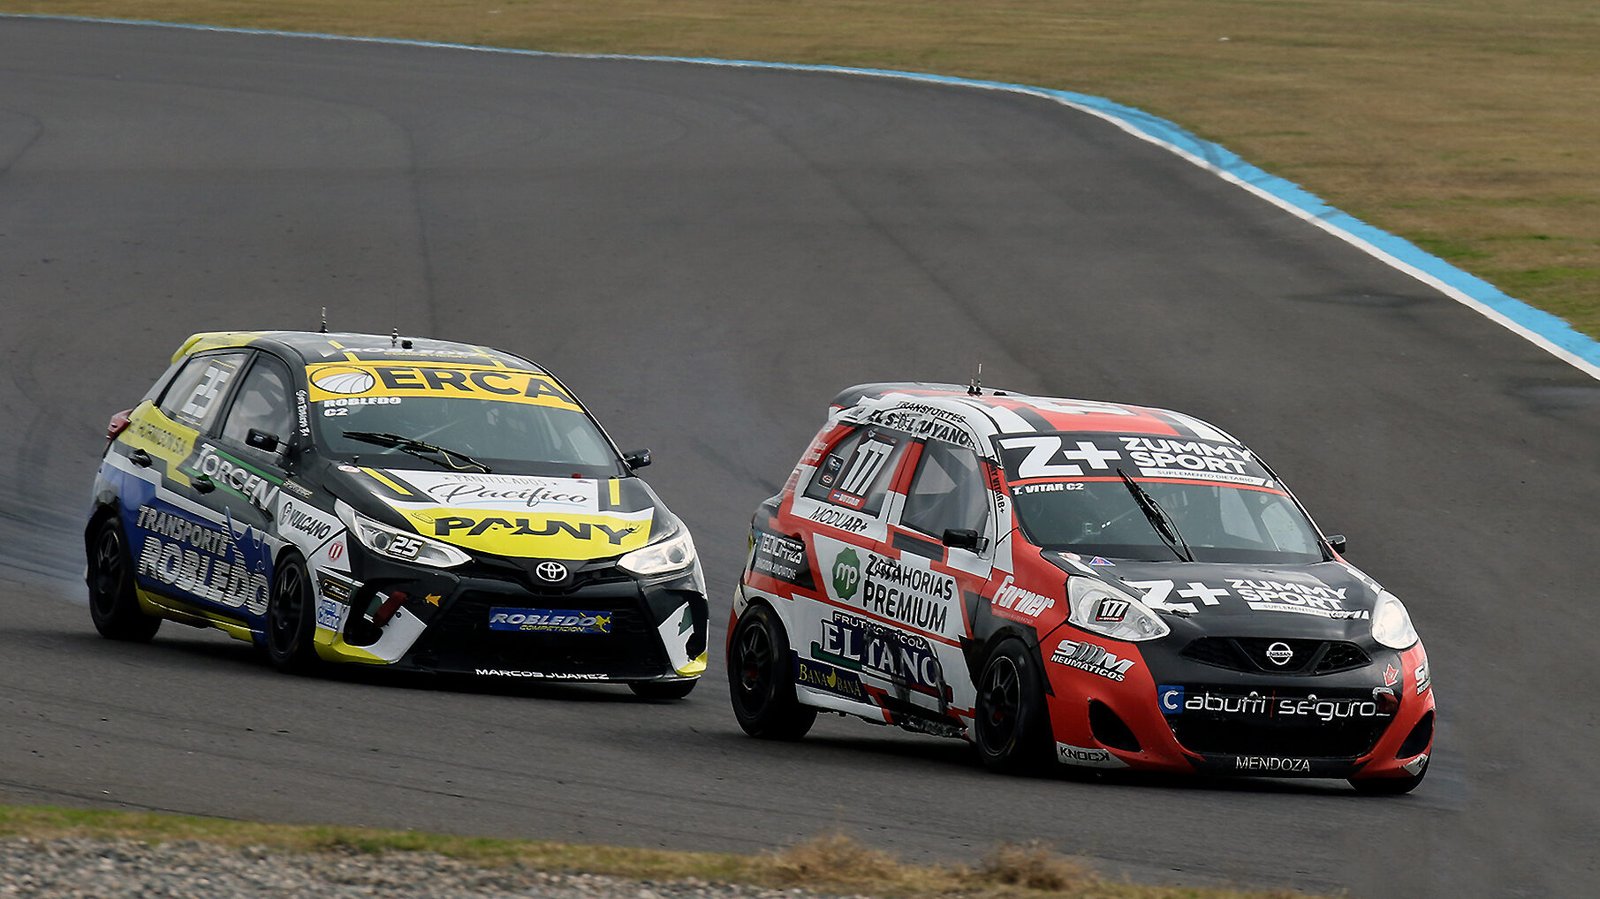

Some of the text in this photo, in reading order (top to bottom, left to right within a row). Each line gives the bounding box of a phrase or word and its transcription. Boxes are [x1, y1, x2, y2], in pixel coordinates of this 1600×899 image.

[181, 366, 230, 419] 25
[373, 366, 577, 404] ERCA
[323, 397, 402, 408] ROBLEDO
[323, 408, 348, 417] C2
[999, 436, 1121, 478] Z+
[1119, 436, 1252, 462] ZUMMY
[1129, 451, 1247, 474] SPORT
[1157, 470, 1214, 479] SUPLEMENTO
[1012, 483, 1084, 496] T. VITAR C2
[136, 504, 228, 557] TRANSPORTE
[289, 508, 331, 539] VULCANO
[434, 516, 634, 546] PAUNY
[389, 535, 423, 557] 25
[137, 535, 270, 616] ROBLEDO
[1223, 578, 1348, 600] ZUMMY
[1237, 589, 1343, 611] SPORT
[862, 579, 948, 634] PREMIUM
[1100, 600, 1129, 617] 177
[490, 613, 597, 627] ROBLEDO
[822, 620, 861, 662] EL
[475, 668, 609, 680] MARCOS JUAREZ
[1050, 655, 1126, 682] NEUMATICOS
[1060, 746, 1110, 761] KNOCK
[1235, 756, 1310, 772] MENDOZA
